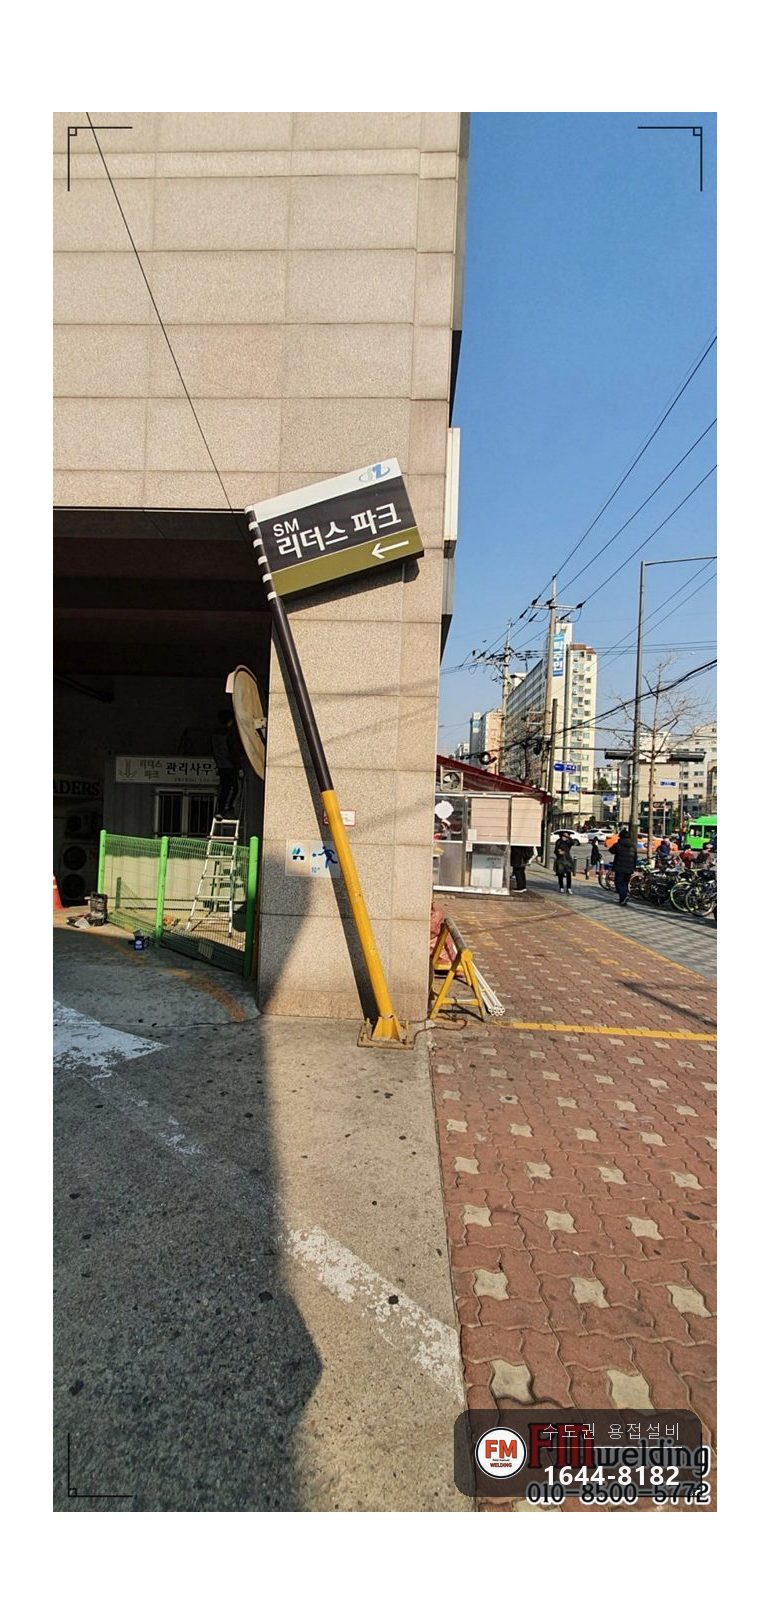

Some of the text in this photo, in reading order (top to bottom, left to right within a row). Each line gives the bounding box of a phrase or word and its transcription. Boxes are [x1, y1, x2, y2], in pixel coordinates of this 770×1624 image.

[273, 518, 300, 537] SM
[276, 502, 402, 559] 리더스 파크
[165, 761, 218, 776] 관리사무
